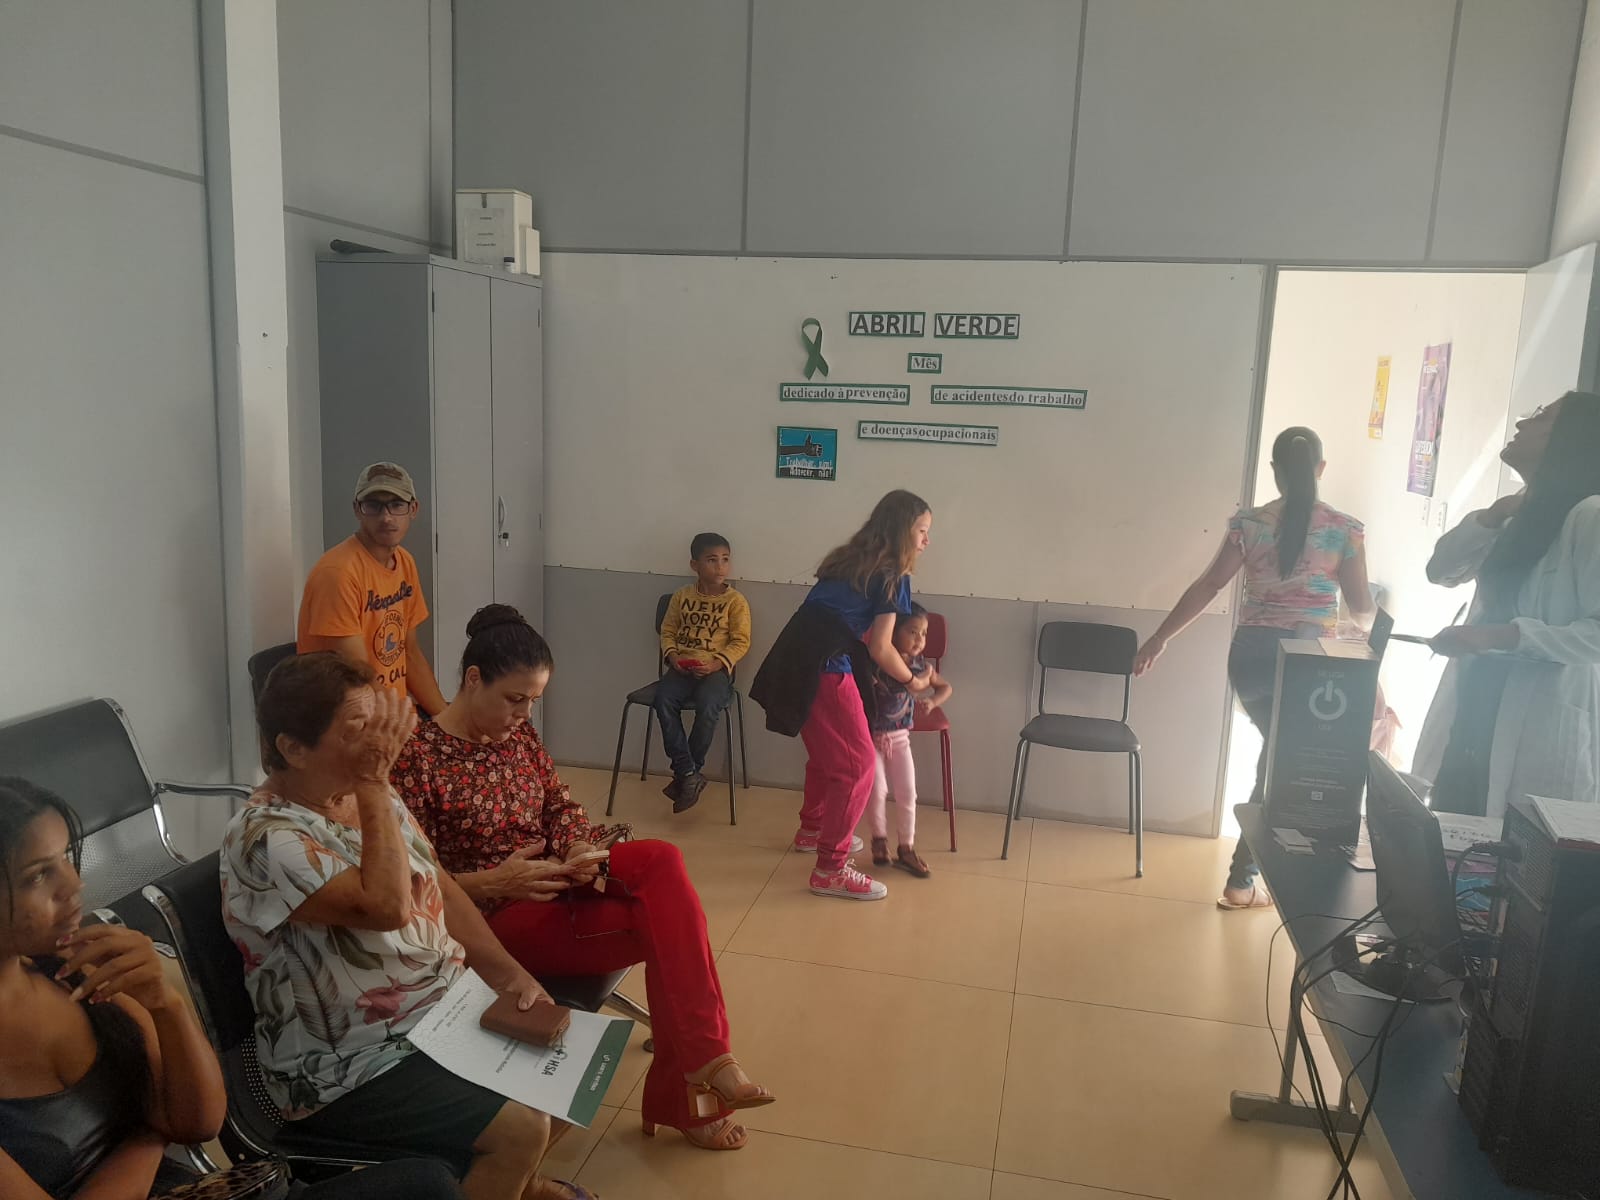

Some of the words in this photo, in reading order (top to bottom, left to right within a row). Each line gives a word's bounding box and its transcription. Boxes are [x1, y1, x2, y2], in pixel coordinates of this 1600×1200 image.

[851, 313, 921, 335] ABRIL
[937, 315, 1017, 336] VERDE
[912, 357, 938, 370] Mês
[783, 387, 835, 399] dedicado
[846, 388, 906, 401] prevenção
[934, 390, 948, 401] de
[1028, 393, 1082, 406] trabalho
[871, 424, 918, 438] doenças
[918, 427, 996, 441] ocupacionais
[681, 598, 727, 613] NEW
[681, 611, 724, 628] YORK
[541, 1058, 560, 1077] HSA
